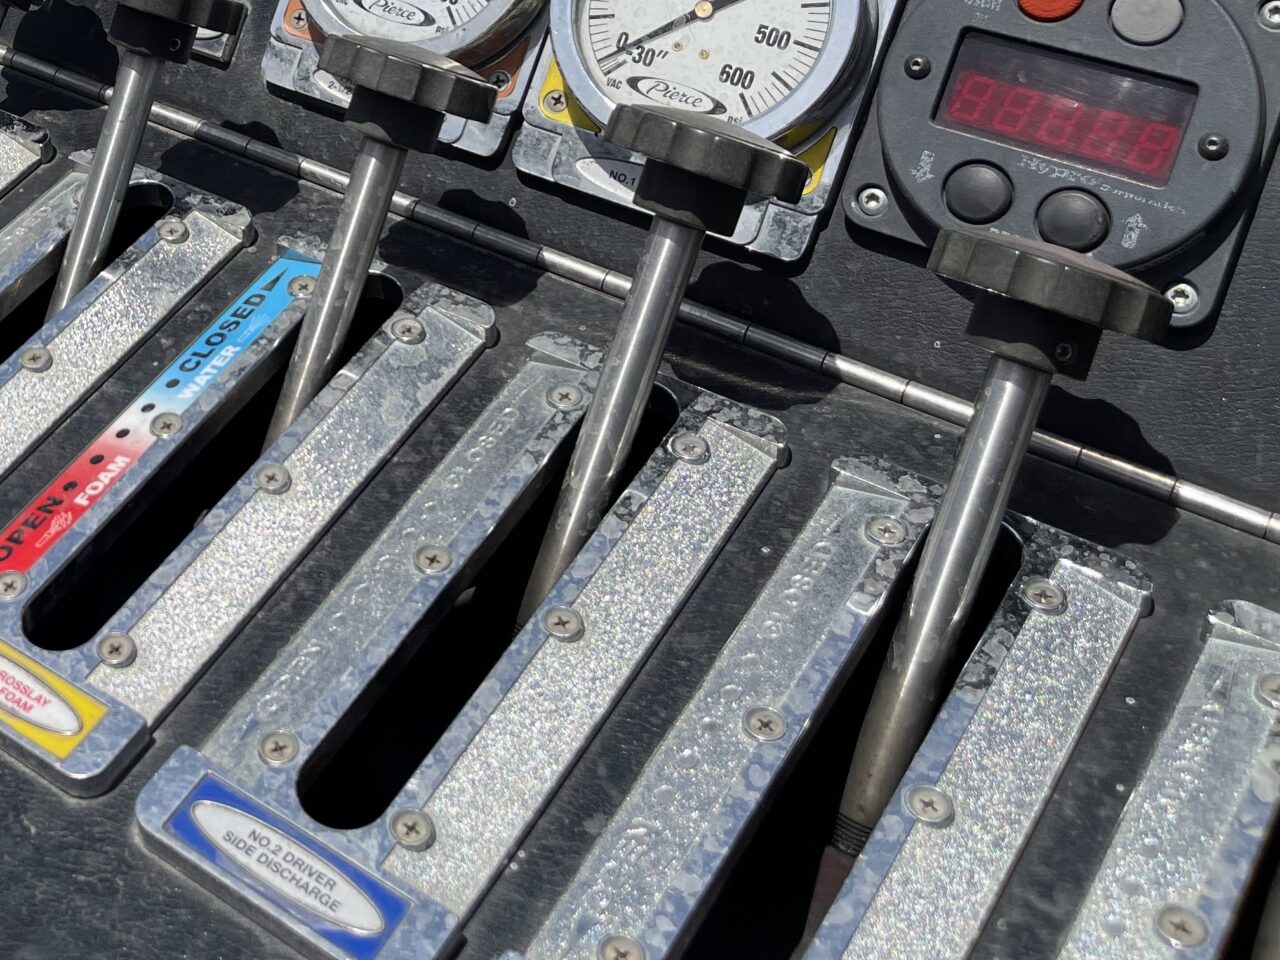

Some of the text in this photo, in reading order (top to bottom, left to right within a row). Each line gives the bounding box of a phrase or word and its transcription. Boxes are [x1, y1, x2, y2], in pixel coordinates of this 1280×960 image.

[754, 24, 791, 50] 500
[606, 76, 623, 90] VAC
[646, 78, 703, 108] Pierce
[719, 64, 755, 90] 600
[608, 169, 637, 186] NO.1
[178, 292, 267, 375] CLOSED
[176, 344, 236, 399] WATER
[73, 453, 129, 508] FOAM
[221, 829, 343, 913] SIDE DISCHARGE
[247, 828, 338, 892] NO.2 DRIVER
